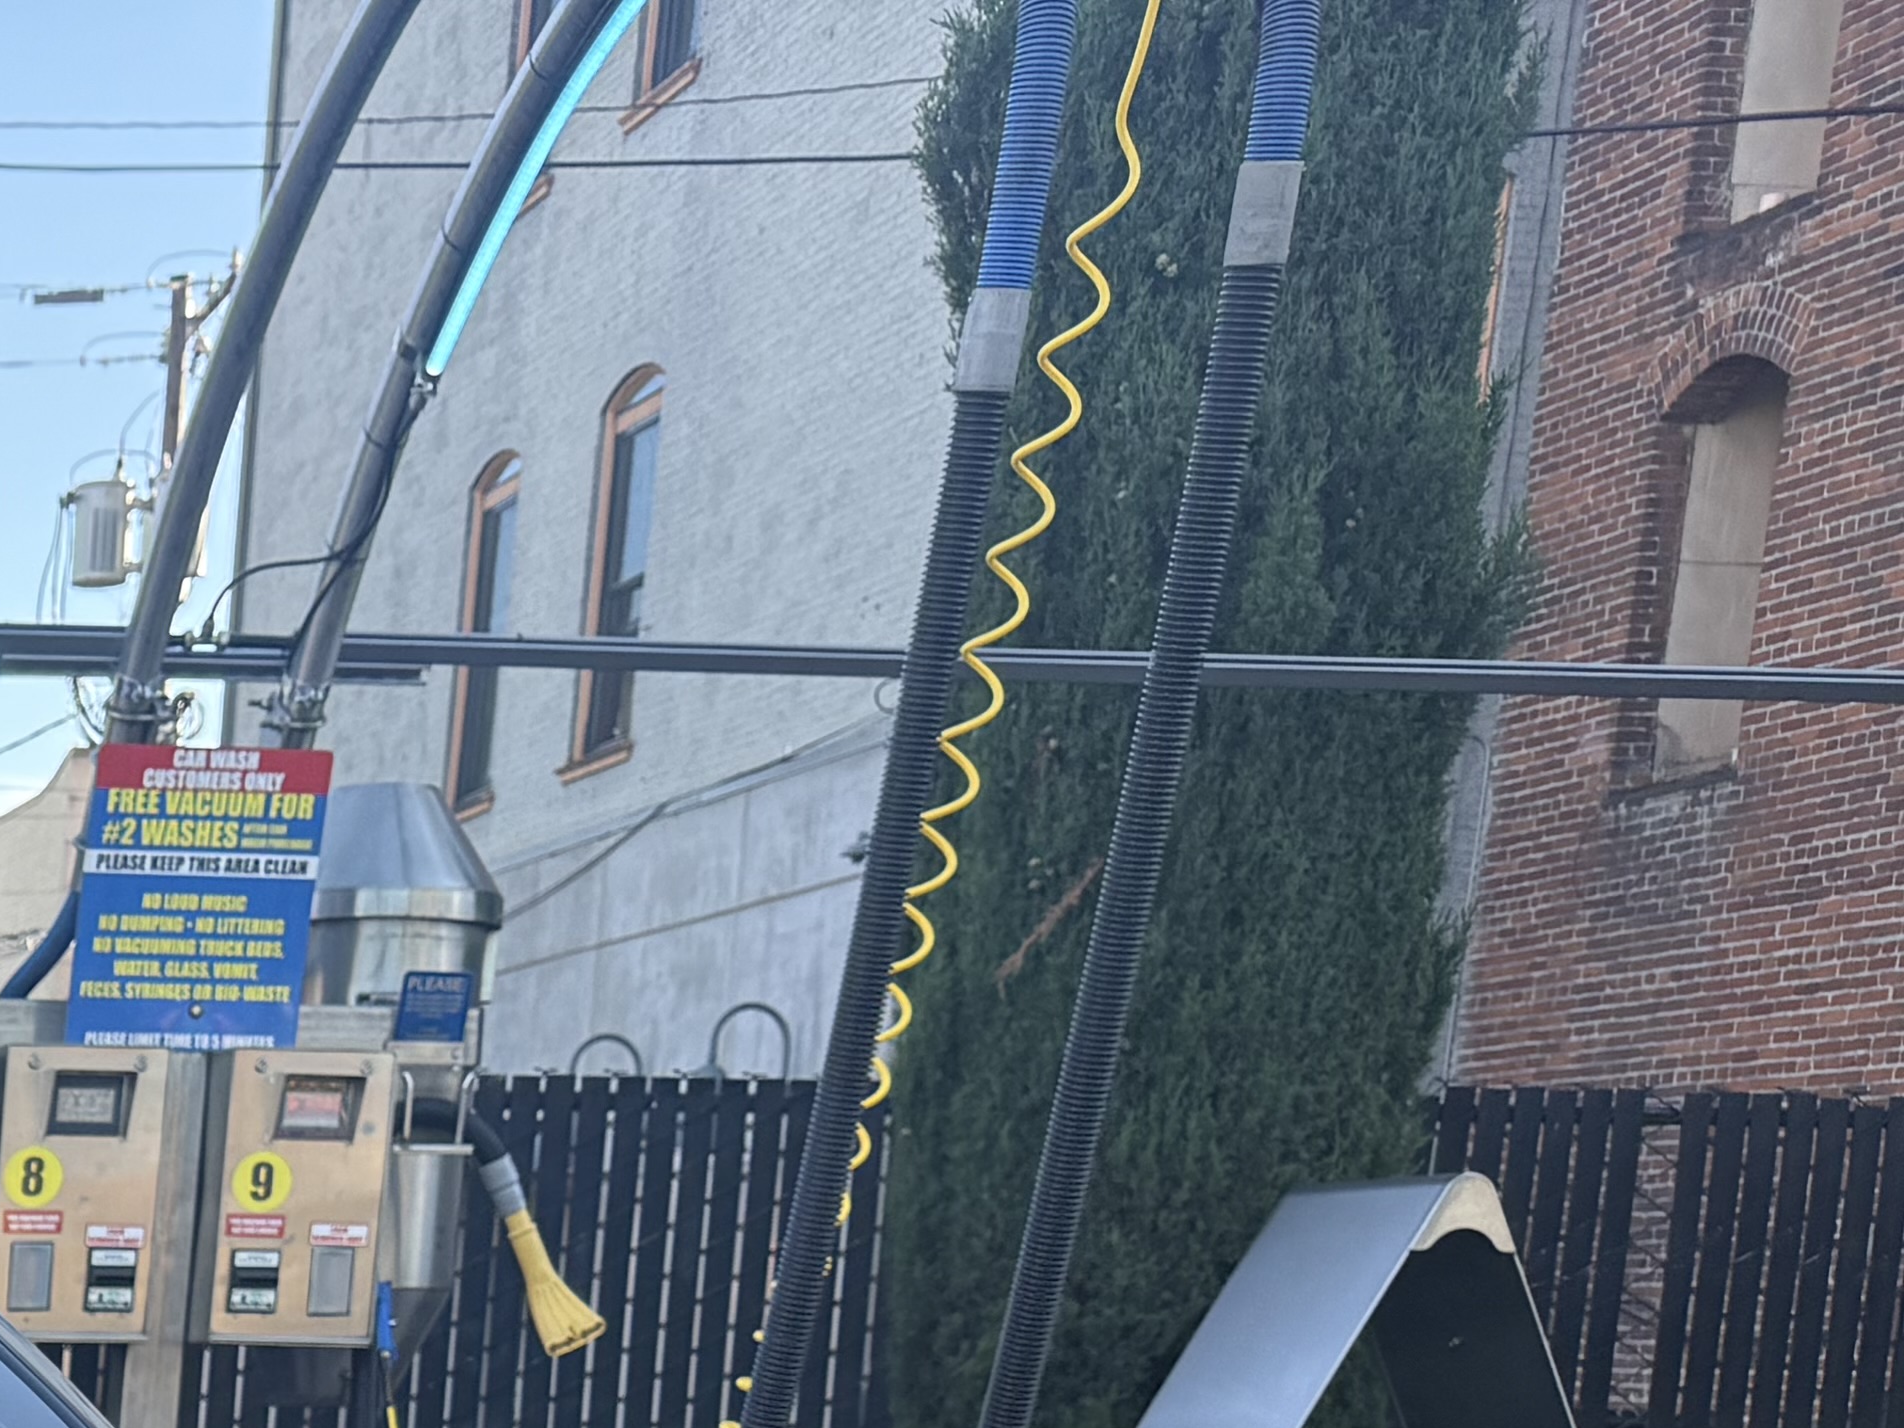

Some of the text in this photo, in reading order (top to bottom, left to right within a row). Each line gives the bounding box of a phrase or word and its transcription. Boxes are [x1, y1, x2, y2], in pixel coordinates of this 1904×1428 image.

[173, 749, 260, 770] CAR WASH
[142, 768, 285, 792] CUSTOMERS ONLY
[106, 788, 316, 820] FREE VACUUM FOR
[102, 817, 137, 845] #2
[140, 818, 239, 848] WASHES
[96, 854, 308, 875] PLEASE KEEP THIS AREA CLEAN
[142, 893, 248, 912] NO LOUD MUSIC
[98, 914, 118, 931] NO
[195, 917, 215, 934] NO
[217, 917, 285, 936] LITTERING
[93, 937, 113, 953] NO
[199, 939, 244, 957] TRUCK
[84, 1032, 127, 1047] PLEASE
[22, 1157, 44, 1197] 8
[250, 1162, 273, 1201] 9
